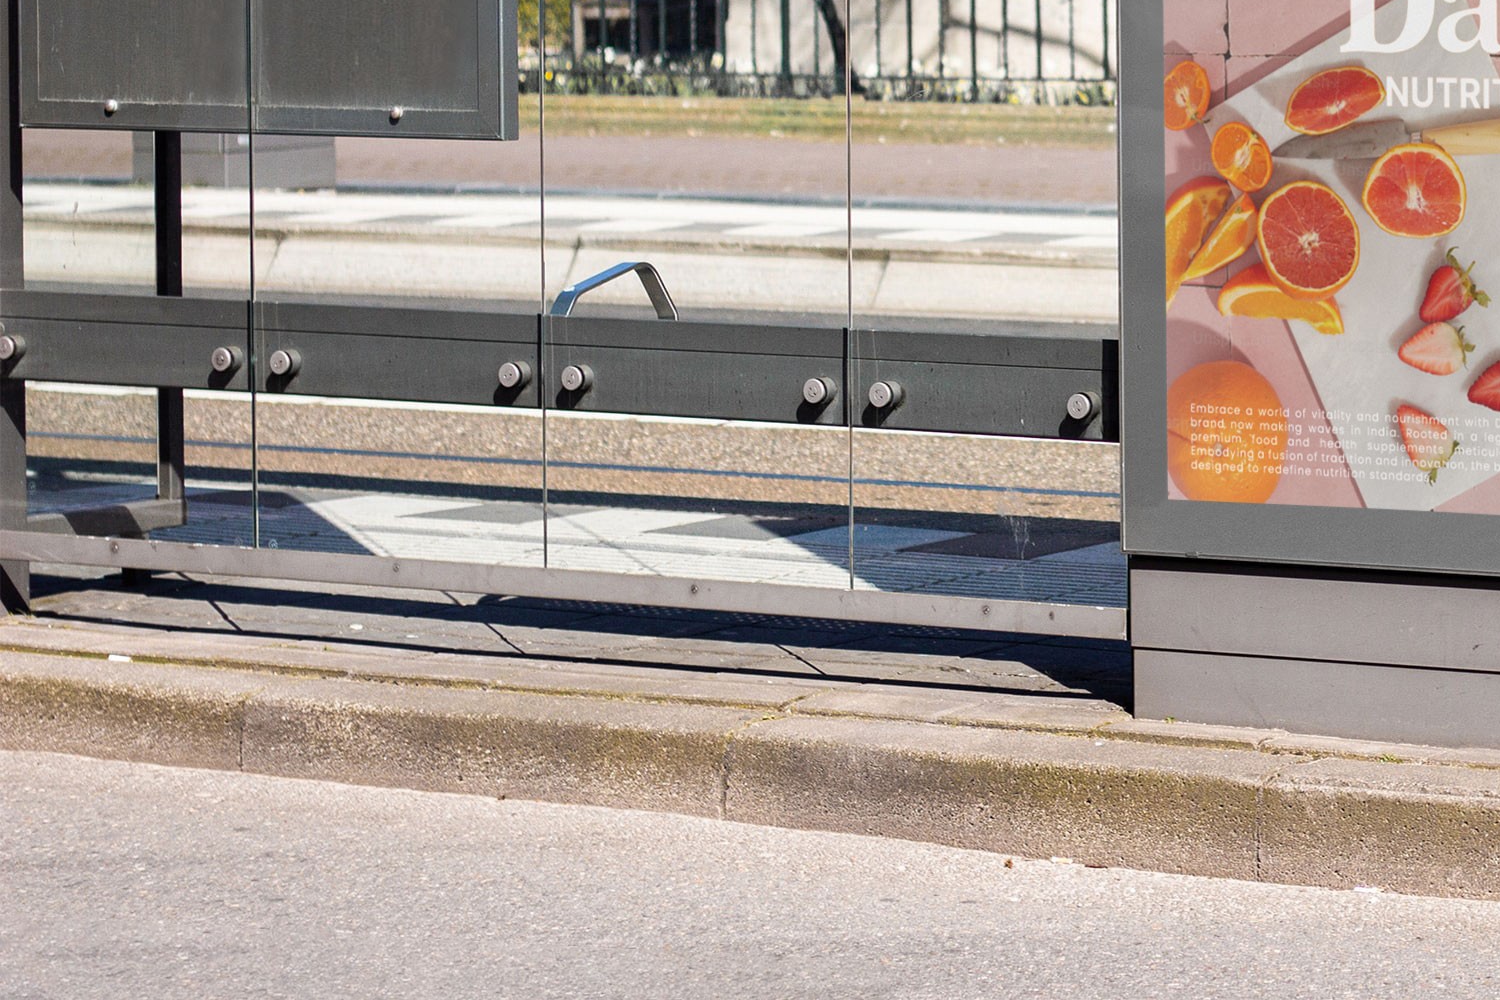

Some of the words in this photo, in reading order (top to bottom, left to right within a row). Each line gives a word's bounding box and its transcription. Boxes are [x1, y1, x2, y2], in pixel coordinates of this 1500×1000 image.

[1191, 403, 1240, 415] Embrace
[1245, 408, 1253, 416] a
[1258, 408, 1289, 417] world
[1295, 409, 1306, 418] of
[1312, 410, 1351, 421] vitality
[1357, 412, 1379, 423] and
[1384, 413, 1459, 427] nourishment
[1465, 417, 1489, 427] with
[1231, 421, 1253, 429] now
[1259, 421, 1302, 434] making
[1308, 425, 1344, 435] waves
[1351, 425, 1361, 435] in
[1367, 426, 1400, 437] India.
[1406, 428, 1448, 440] Rooted
[1454, 431, 1464, 441] in
[1470, 433, 1478, 441] a
[1250, 434, 1278, 445] food
[1288, 438, 1310, 447] and
[1320, 439, 1357, 449] health
[1367, 440, 1444, 455] supplements
[1191, 446, 1254, 461] Embodying
[1268, 449, 1303, 461] fusion
[1307, 452, 1318, 461] of
[1321, 453, 1371, 464] tradition
[1376, 456, 1398, 466] and
[1471, 461, 1490, 471] the
[1191, 460, 1244, 473] designed
[1248, 464, 1258, 473] to
[1263, 465, 1312, 476] redefine
[1315, 467, 1366, 479] nutrition
